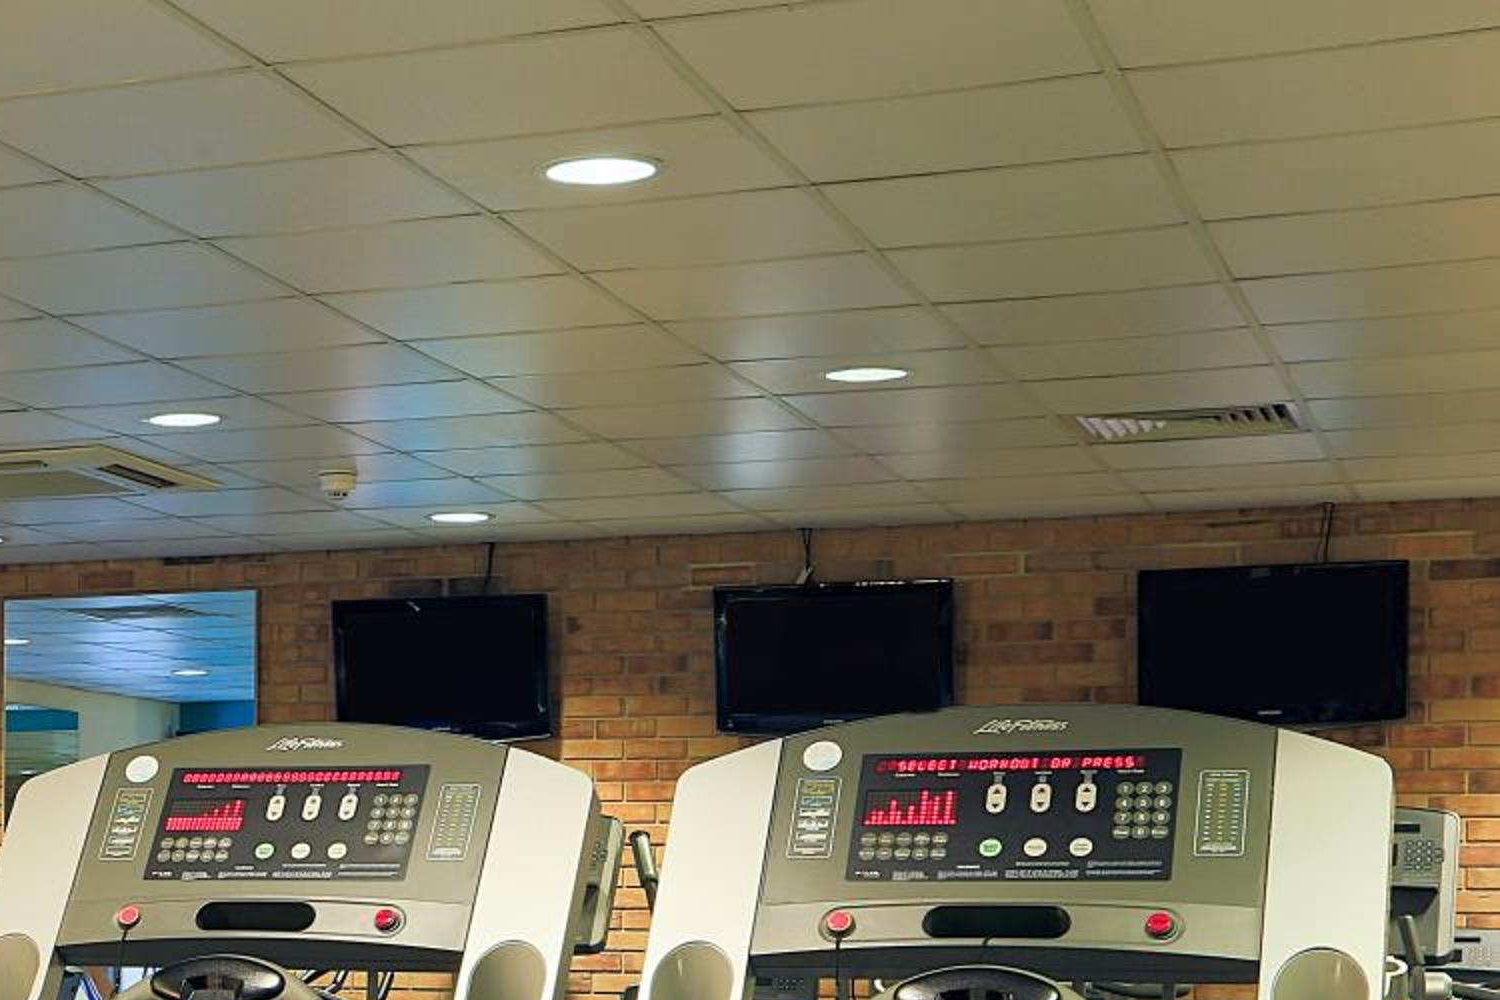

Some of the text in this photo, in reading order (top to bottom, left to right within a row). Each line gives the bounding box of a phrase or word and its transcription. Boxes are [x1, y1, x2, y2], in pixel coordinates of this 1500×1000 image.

[898, 755, 1135, 772] SELECT WORKOUT OR PRESS
